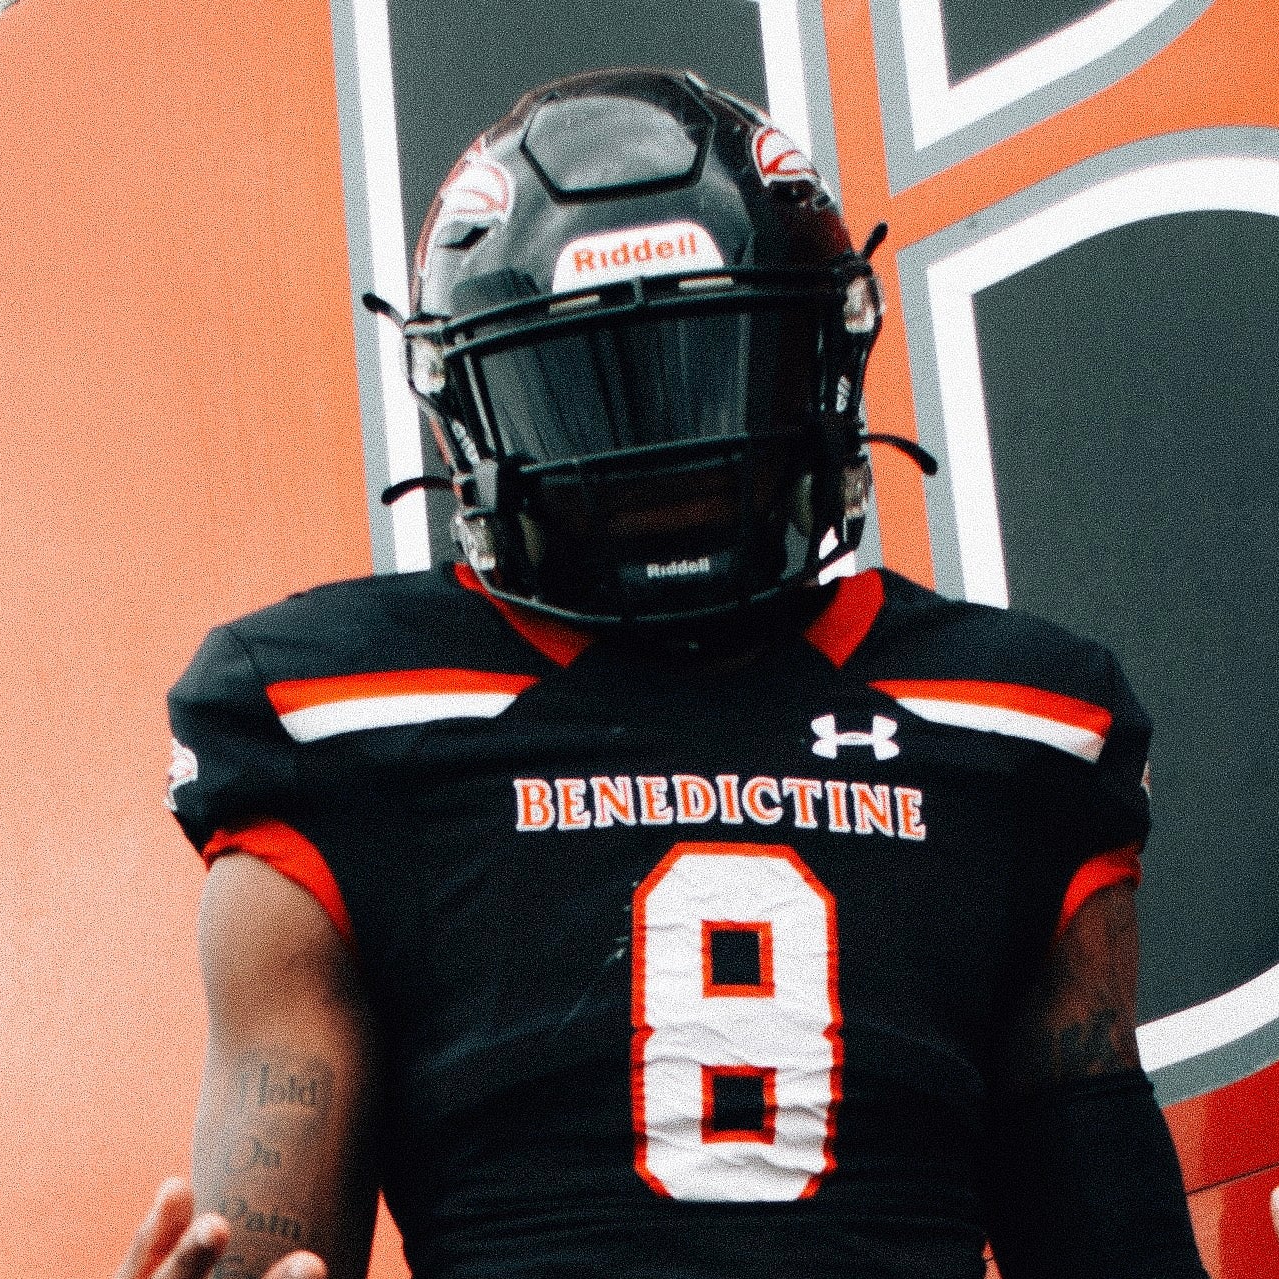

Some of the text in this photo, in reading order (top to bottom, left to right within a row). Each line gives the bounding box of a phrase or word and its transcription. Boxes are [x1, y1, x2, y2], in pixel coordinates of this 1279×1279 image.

[571, 232, 699, 273] Riddell
[646, 556, 711, 578] Riddell
[513, 774, 927, 842] BENEDICTINE
[631, 840, 843, 1202] 8
